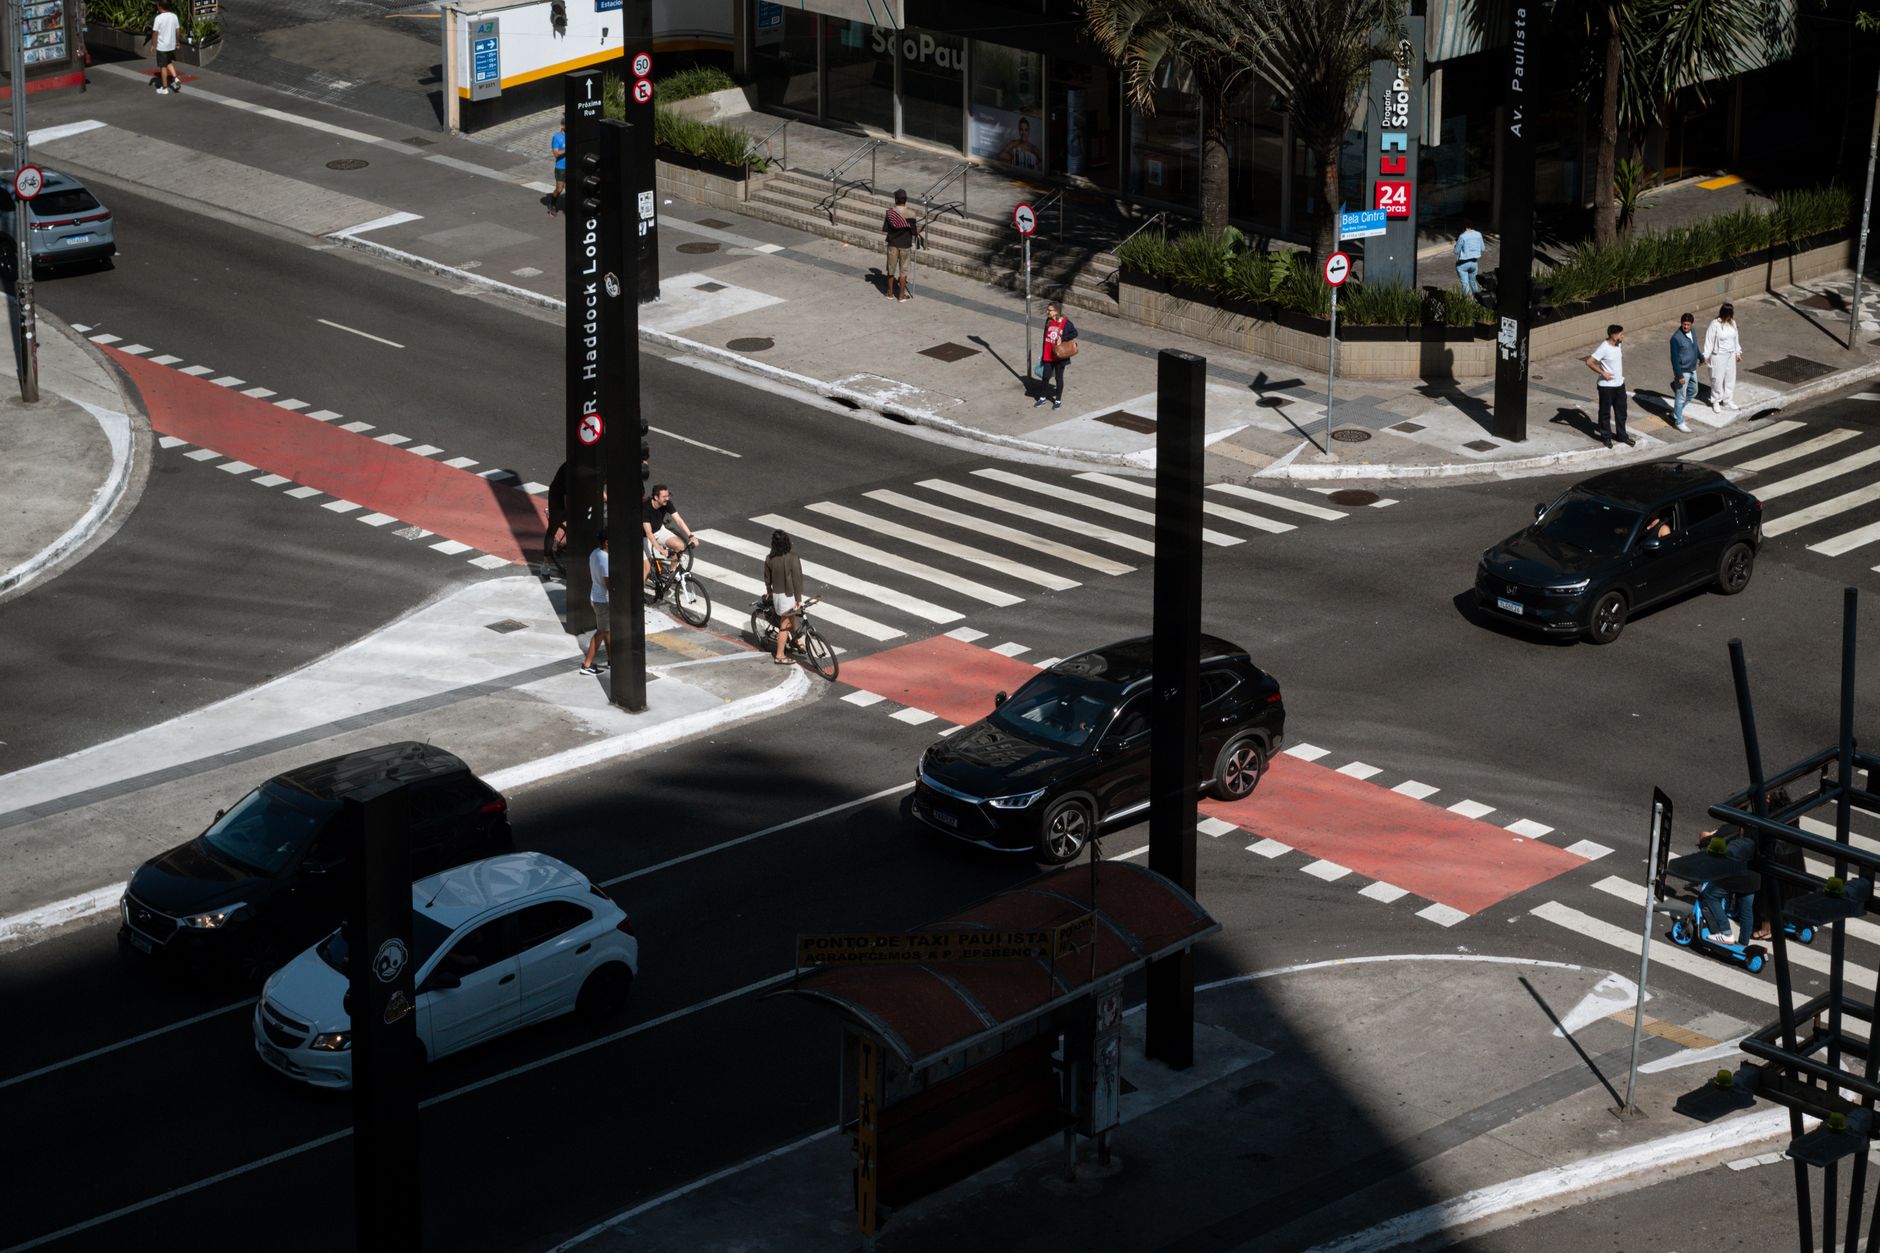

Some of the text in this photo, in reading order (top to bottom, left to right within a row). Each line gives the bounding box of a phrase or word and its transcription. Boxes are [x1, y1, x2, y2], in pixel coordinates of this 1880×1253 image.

[636, 58, 649, 71] 50
[1510, 7, 1526, 139] Av. Paulista
[1392, 39, 1410, 127] SãoPa
[577, 99, 602, 110] Próxima
[583, 109, 596, 117] Rua
[1382, 89, 1391, 127] Drogaria
[1380, 186, 1407, 204] 24
[1342, 211, 1385, 225] Bela Cintra
[583, 218, 598, 414] R. Haddock Lobo
[804, 936, 869, 949] PONTO
[875, 935, 900, 947] DE
[905, 934, 949, 947] TAXI
[862, 1043, 872, 1228] TAXI
